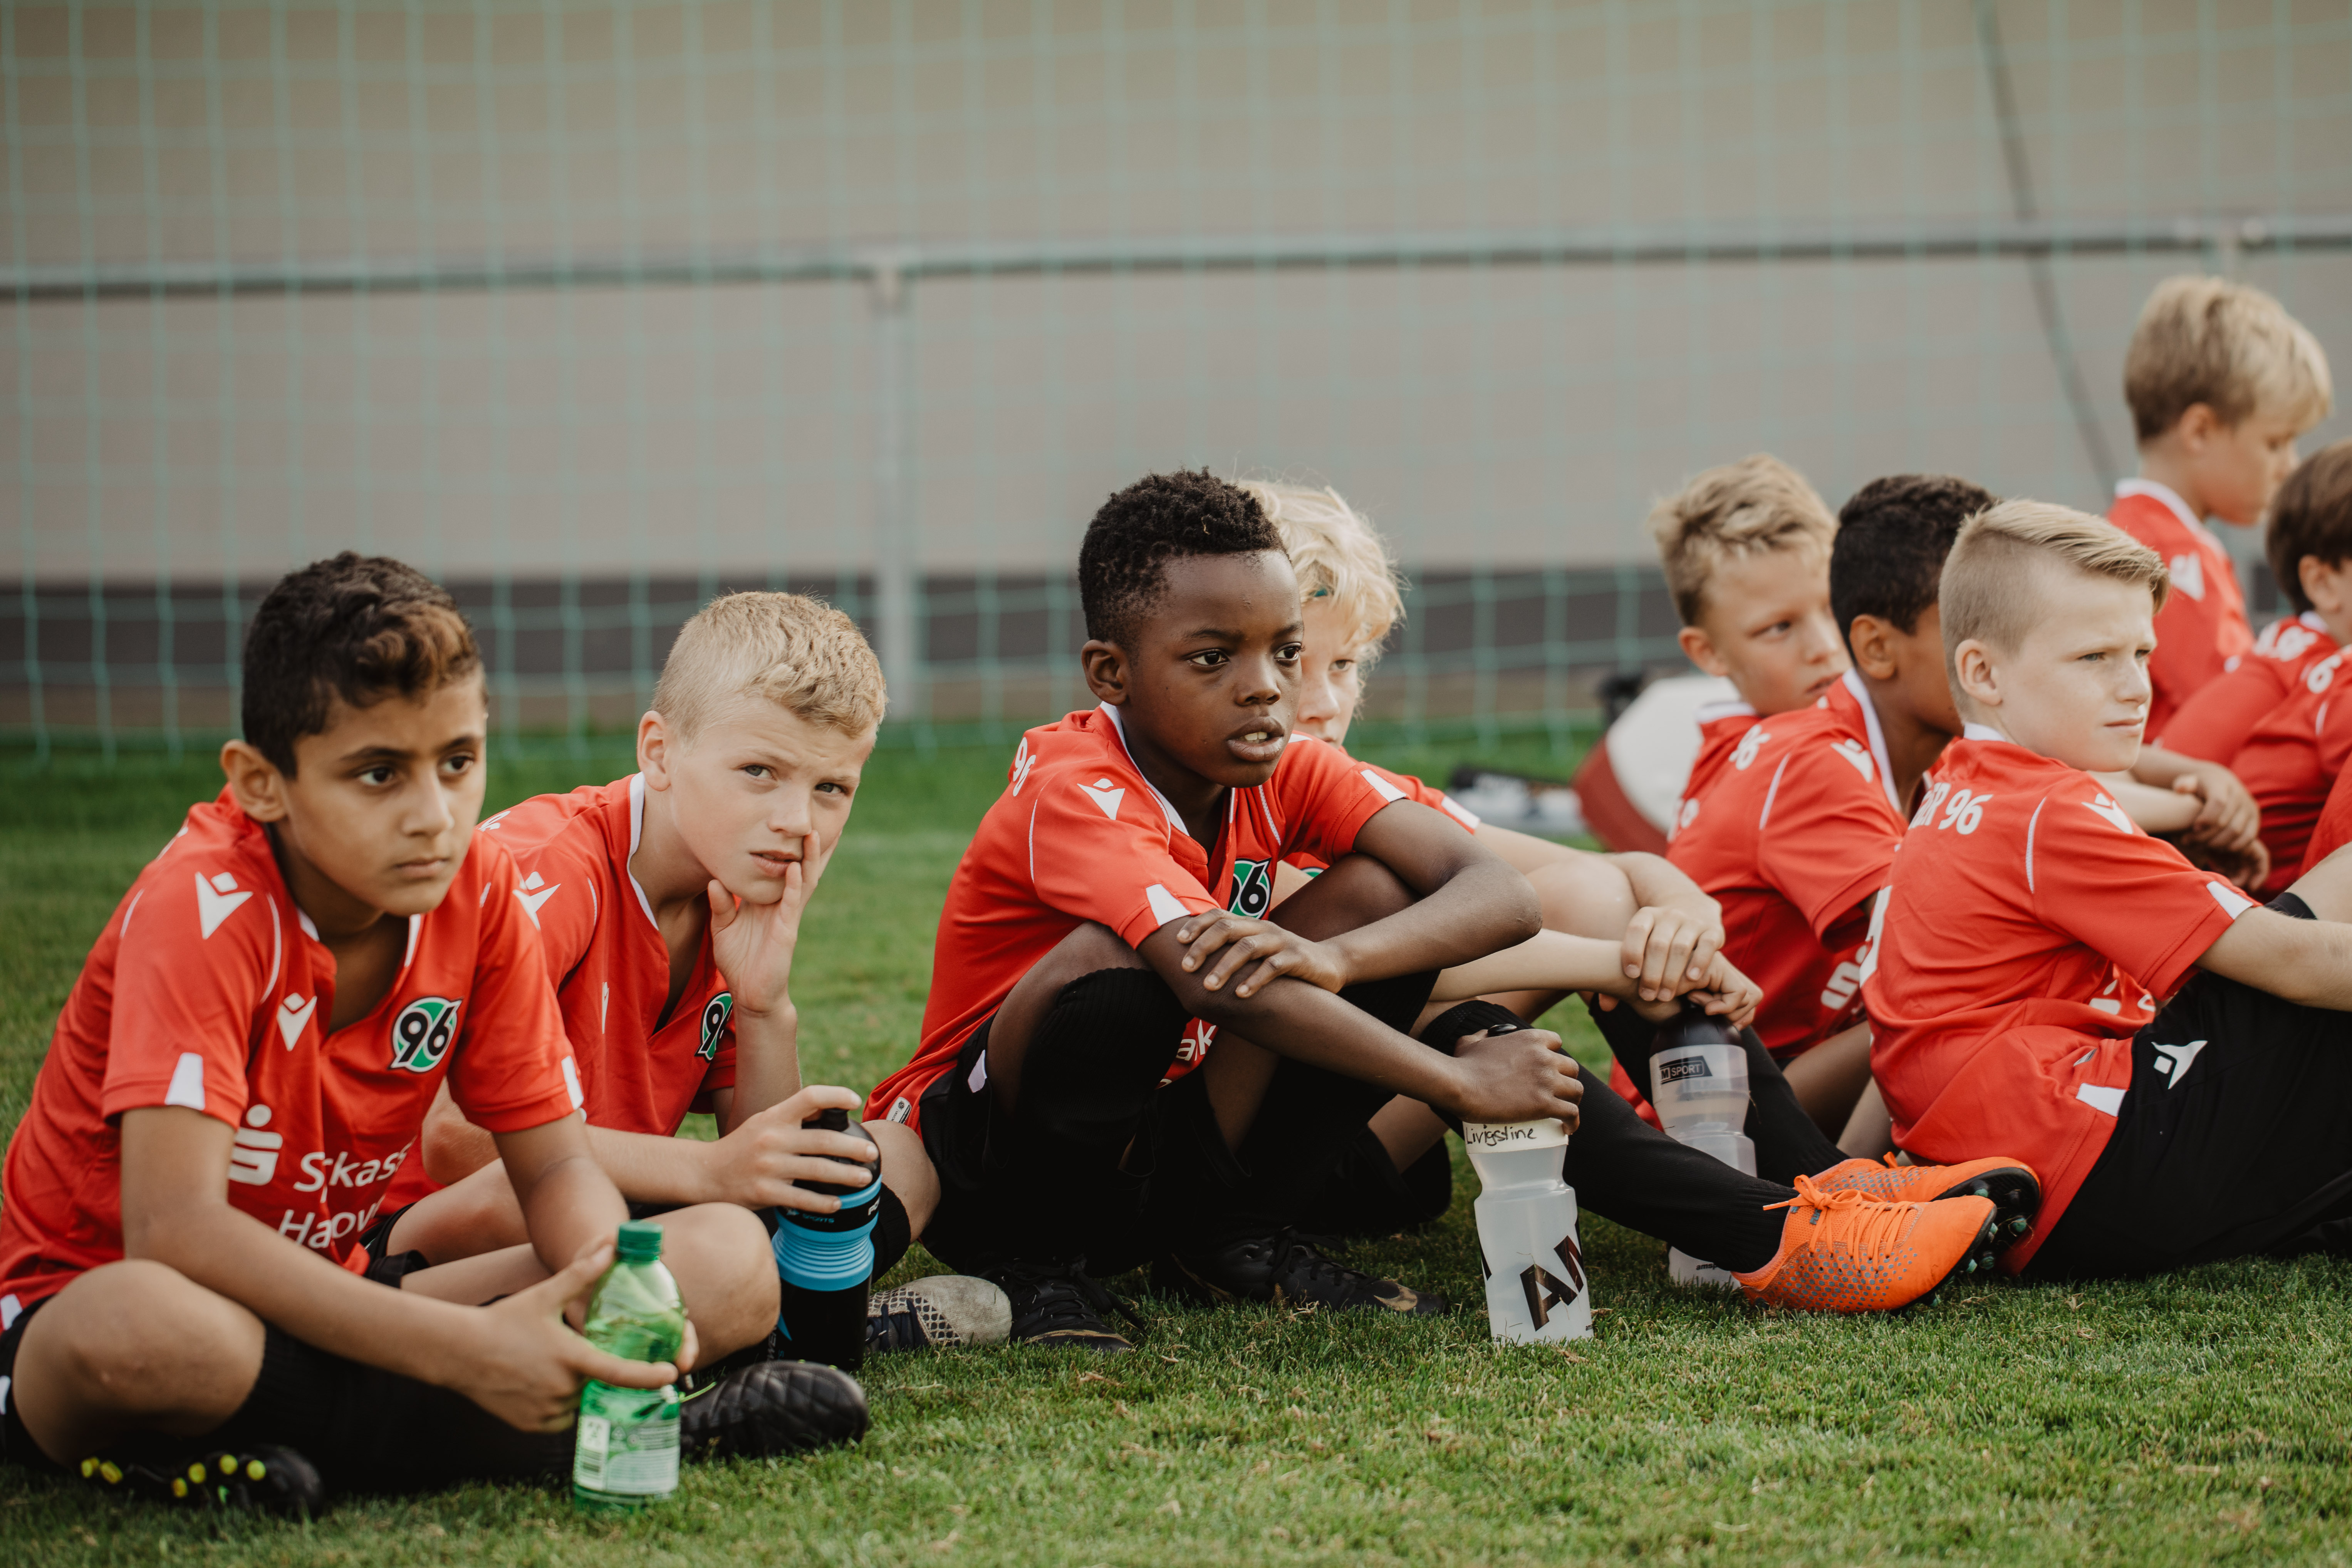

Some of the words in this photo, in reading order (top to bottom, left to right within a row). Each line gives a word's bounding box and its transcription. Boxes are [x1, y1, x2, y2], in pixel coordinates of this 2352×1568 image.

[1013, 737, 1036, 797] 96
[1938, 788, 1994, 835] 96
[395, 1001, 458, 1066] 96
[700, 1001, 733, 1055] 9
[1671, 1063, 1702, 1077] SPORT
